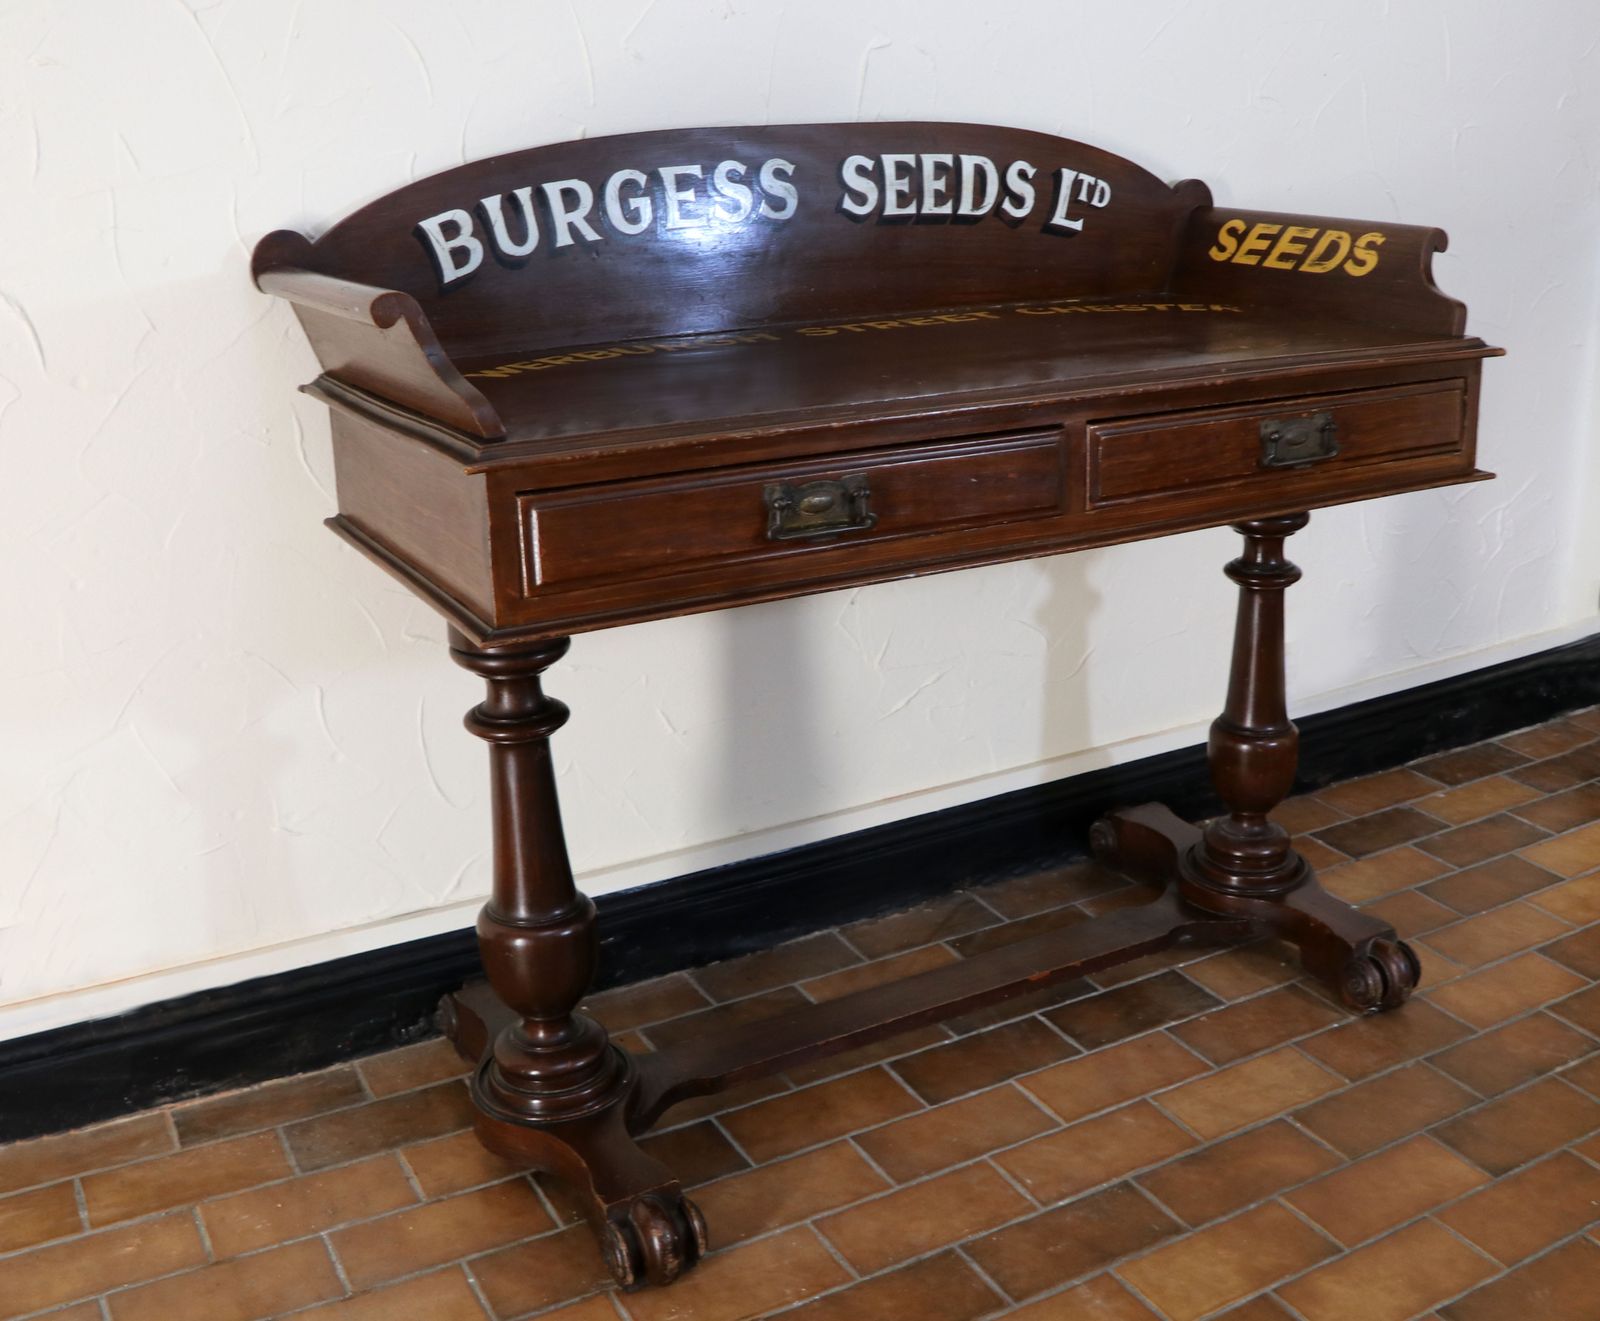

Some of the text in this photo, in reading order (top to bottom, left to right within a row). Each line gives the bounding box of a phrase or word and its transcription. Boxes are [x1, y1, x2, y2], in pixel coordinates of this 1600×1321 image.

[417, 157, 799, 284] BURGESS
[841, 153, 1037, 218] SEEDS
[1208, 218, 1387, 277] SEEDS
[796, 310, 1003, 337] STREET
[1015, 303, 1244, 316] CHESTER
